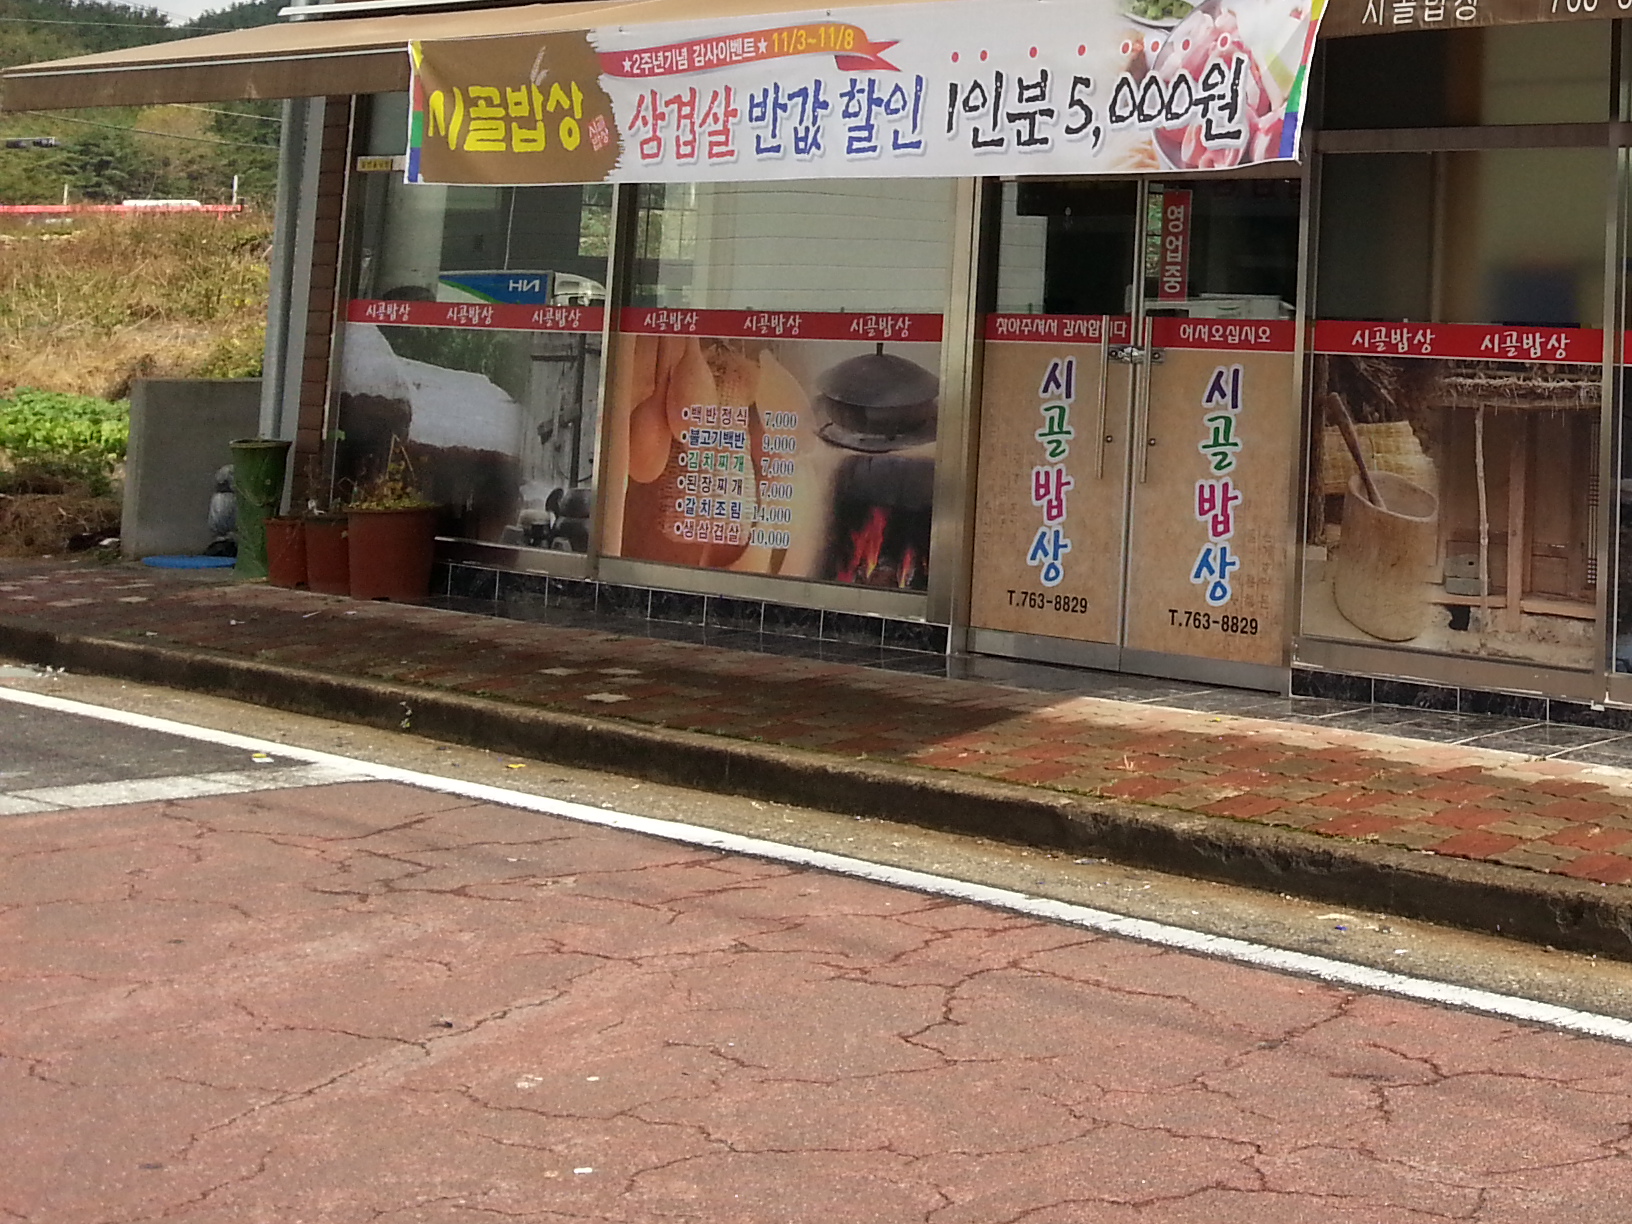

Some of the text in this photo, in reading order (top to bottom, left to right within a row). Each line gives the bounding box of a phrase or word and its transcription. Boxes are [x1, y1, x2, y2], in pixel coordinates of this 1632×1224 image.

[632, 22, 856, 74] 2주년기념 감사이벤트 11/3~11/8
[428, 80, 584, 153] 시골밥상
[628, 57, 1248, 161] 삼겹살 반값 할인 1인분 5,000원
[1162, 205, 1185, 294] 영업중
[447, 304, 494, 325] 시골밥상
[532, 307, 582, 328] 시골밥상
[643, 310, 699, 332] 시골밥상
[744, 313, 803, 336] 시골밥상
[849, 315, 913, 338] 시골밥상
[1180, 324, 1271, 345] 어서오십시오
[1351, 326, 1436, 354] 시골밥상
[1480, 331, 1571, 359] 시골밥상
[764, 412, 798, 428] 7,000
[689, 428, 797, 452] 불고기백반 9,000
[761, 458, 795, 475] 7,000
[1029, 359, 1074, 583] 시골밥상
[760, 482, 793, 499] 7,000
[1194, 367, 1241, 602] 시골밥상
[752, 505, 792, 523] 14,000
[750, 528, 790, 547] 10,000
[1006, 590, 1089, 614] T.763-8829
[1168, 609, 1259, 636] T.763-8829
